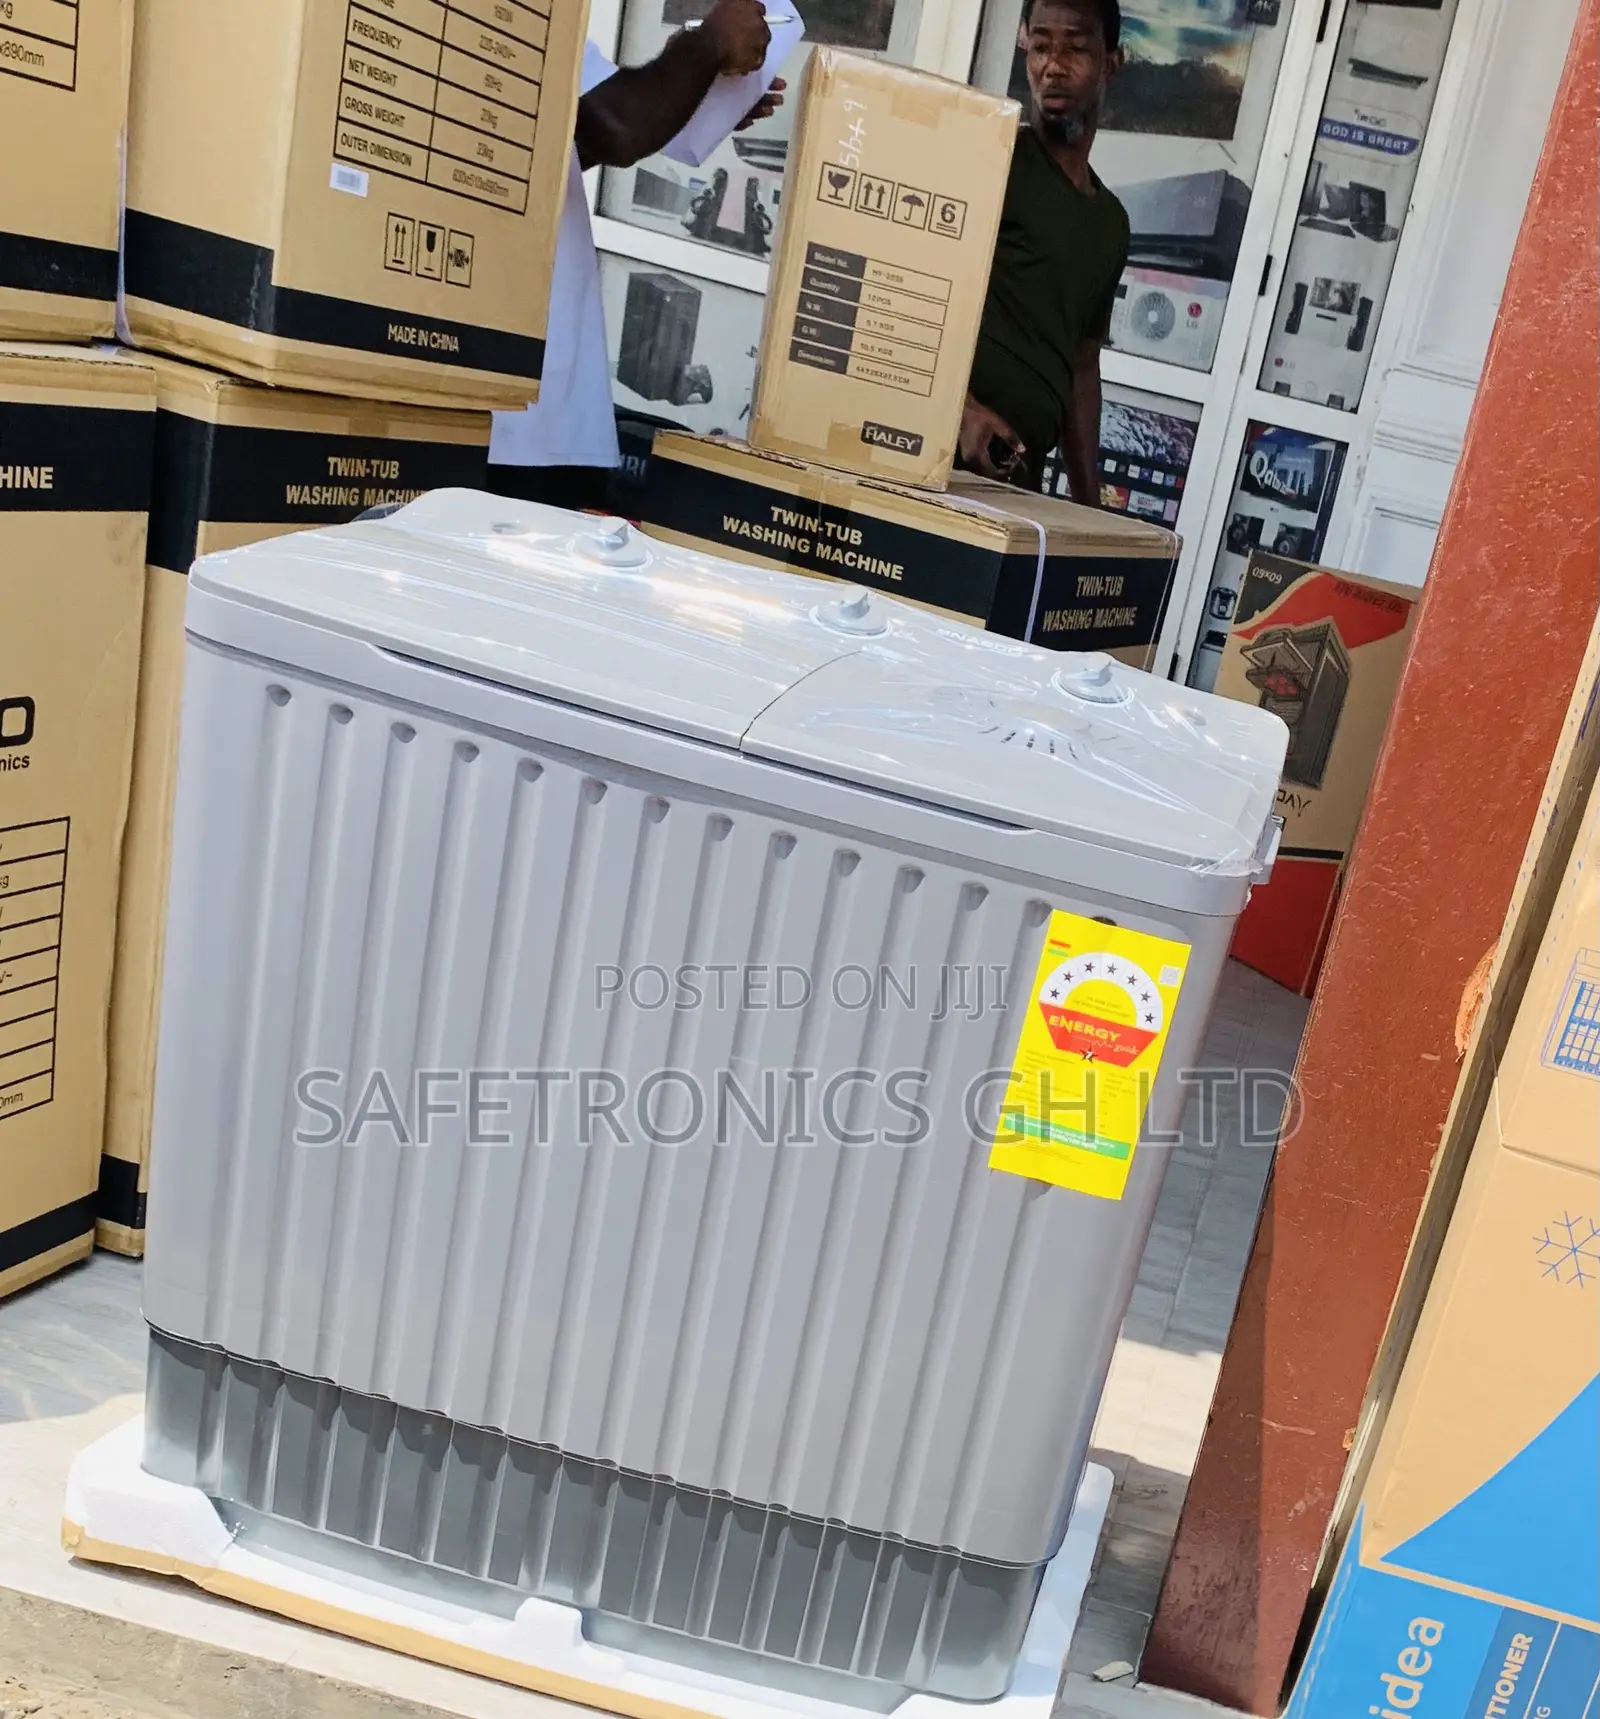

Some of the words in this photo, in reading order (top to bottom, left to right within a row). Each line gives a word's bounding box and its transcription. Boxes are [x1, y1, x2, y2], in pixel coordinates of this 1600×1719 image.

[352, 19, 402, 50] FREQUENCY
[348, 57, 366, 75] NET
[366, 62, 398, 87] WEIGHT
[344, 96, 374, 118] GROSS
[374, 107, 406, 128] WEIGHT
[340, 133, 368, 152] OUTER
[369, 140, 413, 167] DIMENSION
[940, 203, 957, 224] 6
[387, 322, 417, 345] MADE
[417, 328, 429, 347] IN
[429, 331, 459, 353] CHINA
[327, 456, 400, 479] TWIN-TUB
[286, 485, 361, 506] WASHING
[770, 506, 864, 545] TWIN-TUB
[722, 515, 811, 554] WASHING
[815, 541, 905, 581] MACHINE
[1076, 575, 1124, 598] TWIN-TUB
[1042, 607, 1093, 633] WASHING
[1093, 606, 1138, 629] MACHINE
[1048, 1014, 1122, 1043] ENERGY
